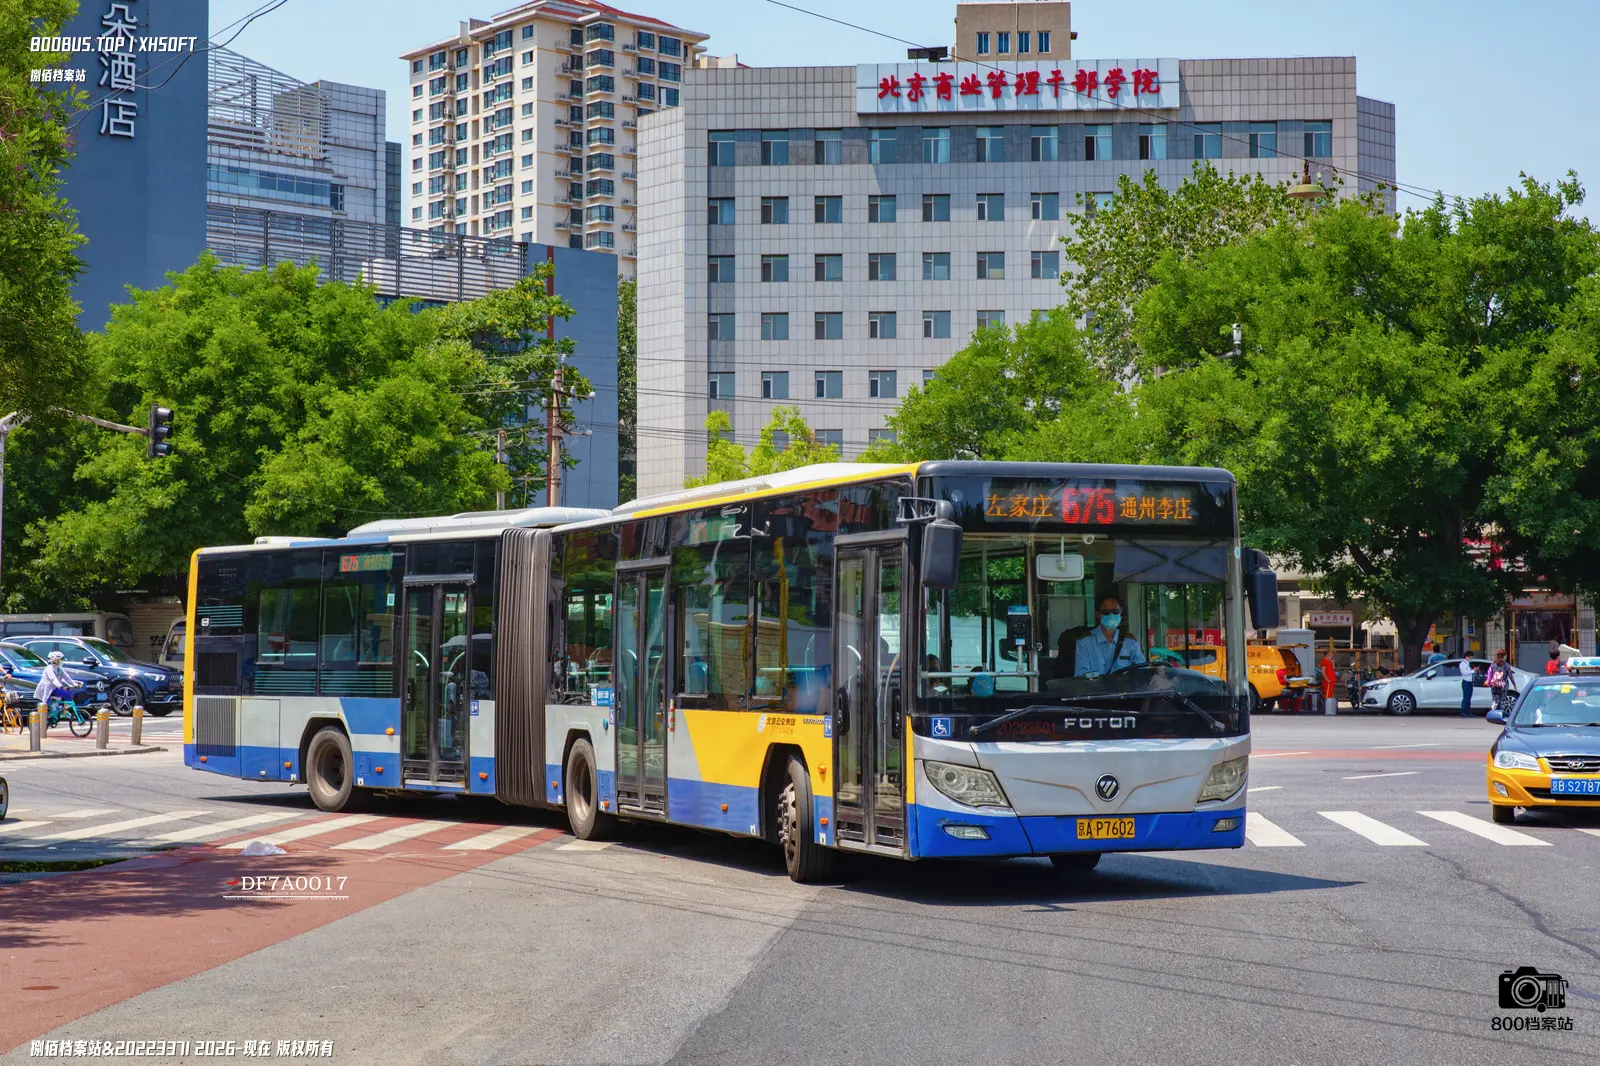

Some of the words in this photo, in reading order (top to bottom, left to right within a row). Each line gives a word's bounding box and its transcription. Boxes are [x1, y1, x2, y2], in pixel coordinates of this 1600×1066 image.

[877, 68, 1161, 103] 北京商业管理干部学院
[984, 493, 1054, 518] 左家庄
[1062, 487, 1115, 525] 675
[1120, 496, 1193, 521] 通州李庄
[341, 555, 359, 572] 675
[1064, 716, 1136, 729] FOTON
